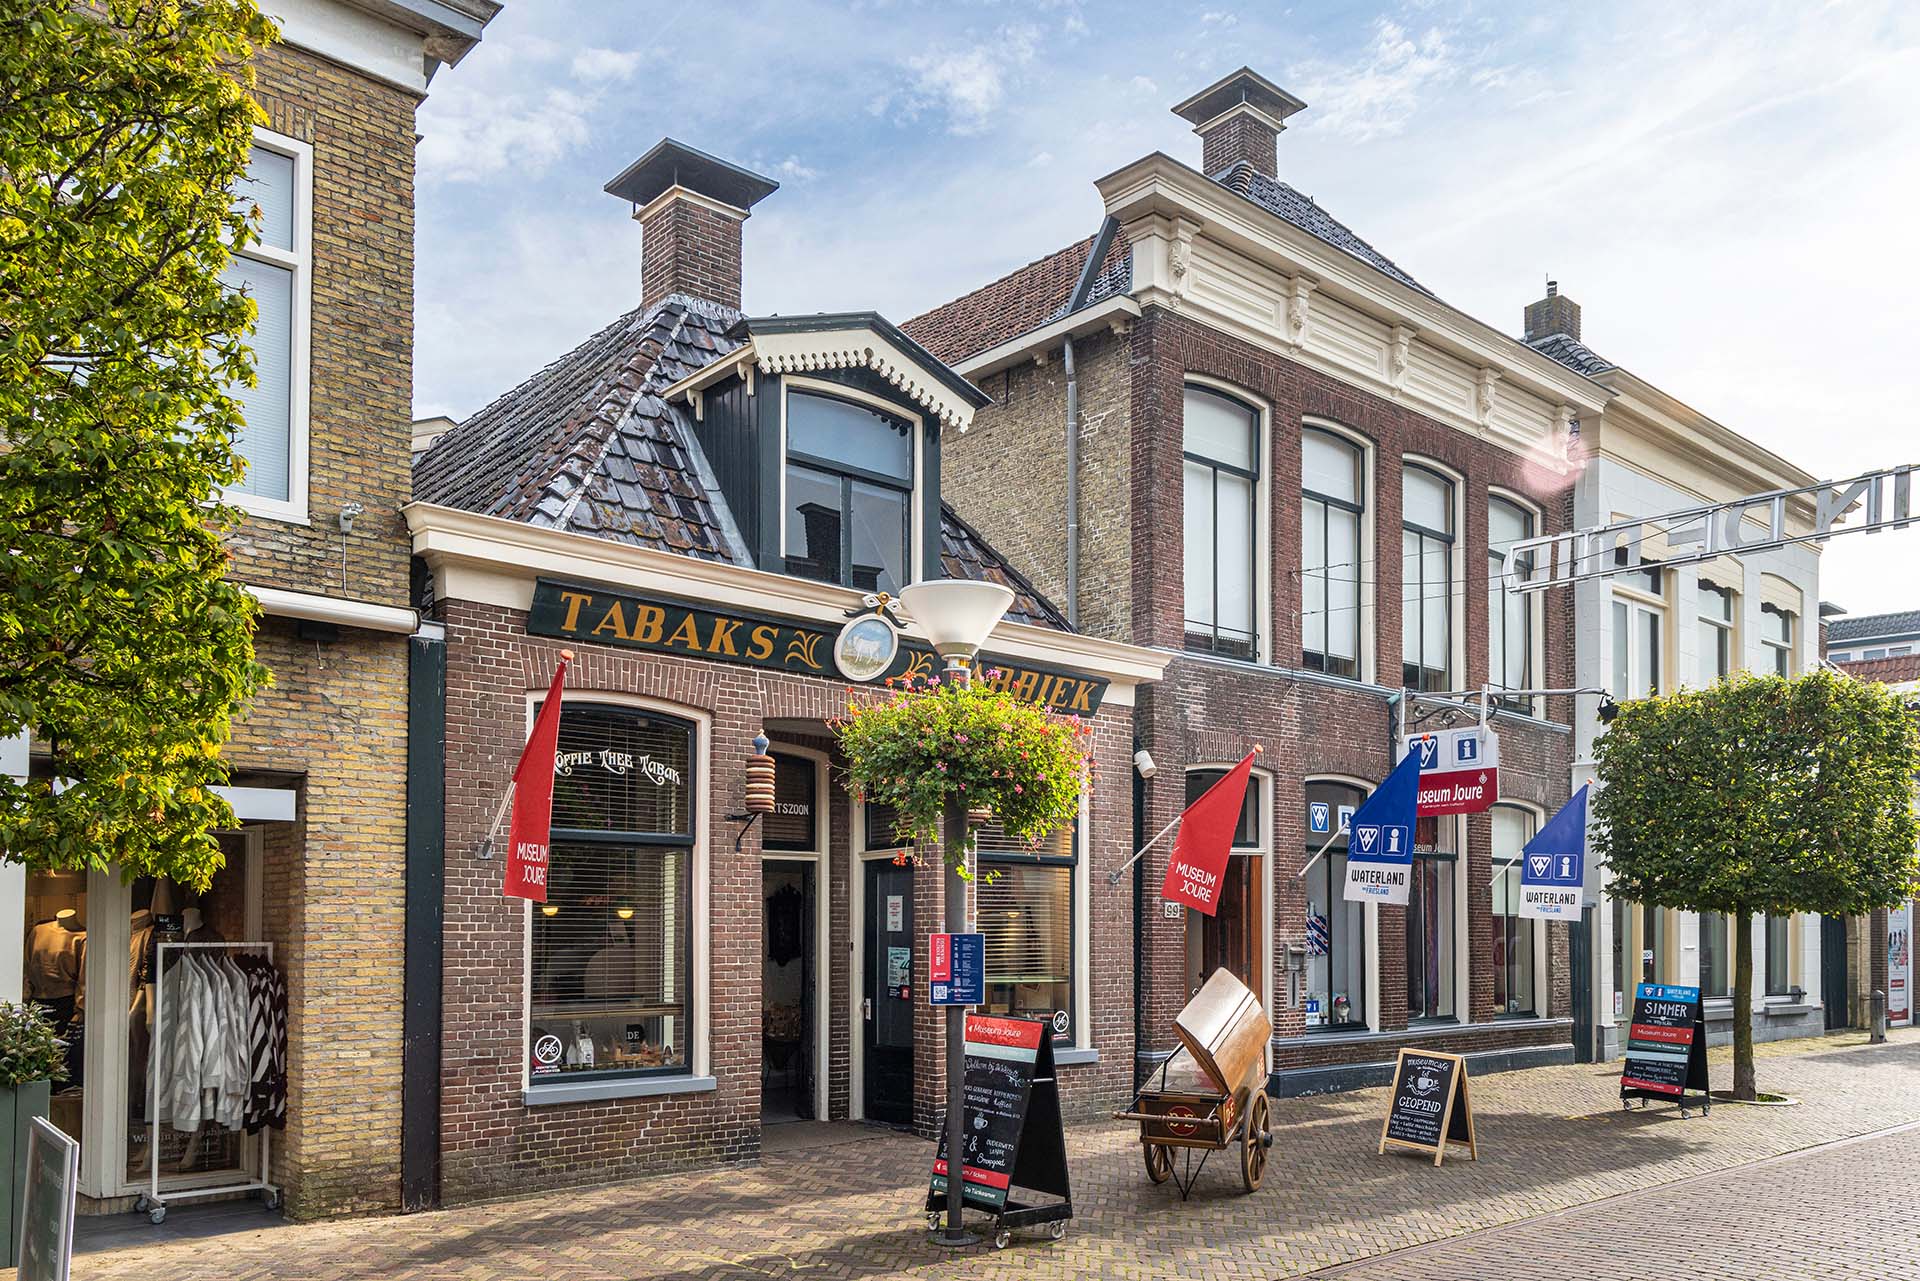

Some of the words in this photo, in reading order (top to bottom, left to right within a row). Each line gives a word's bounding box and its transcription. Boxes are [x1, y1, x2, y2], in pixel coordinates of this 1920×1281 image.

[560, 591, 779, 660] TABAKS
[1416, 788, 1451, 804] useum
[1453, 784, 1483, 802] Joure
[774, 802, 809, 816] TSZOON
[516, 842, 548, 863] MUSEUM
[522, 864, 545, 886] JOURE
[1175, 861, 1217, 888] MUSEUM
[1351, 869, 1405, 886] WATERLAND
[1180, 880, 1213, 903] JOURE
[1526, 891, 1576, 905] WATERLAND
[1644, 1001, 1688, 1018] SIMMER
[627, 1031, 640, 1040] DE
[973, 1023, 1001, 1035] Museum
[1399, 1096, 1442, 1113] GEOPEND
[969, 1136, 977, 1152] &
